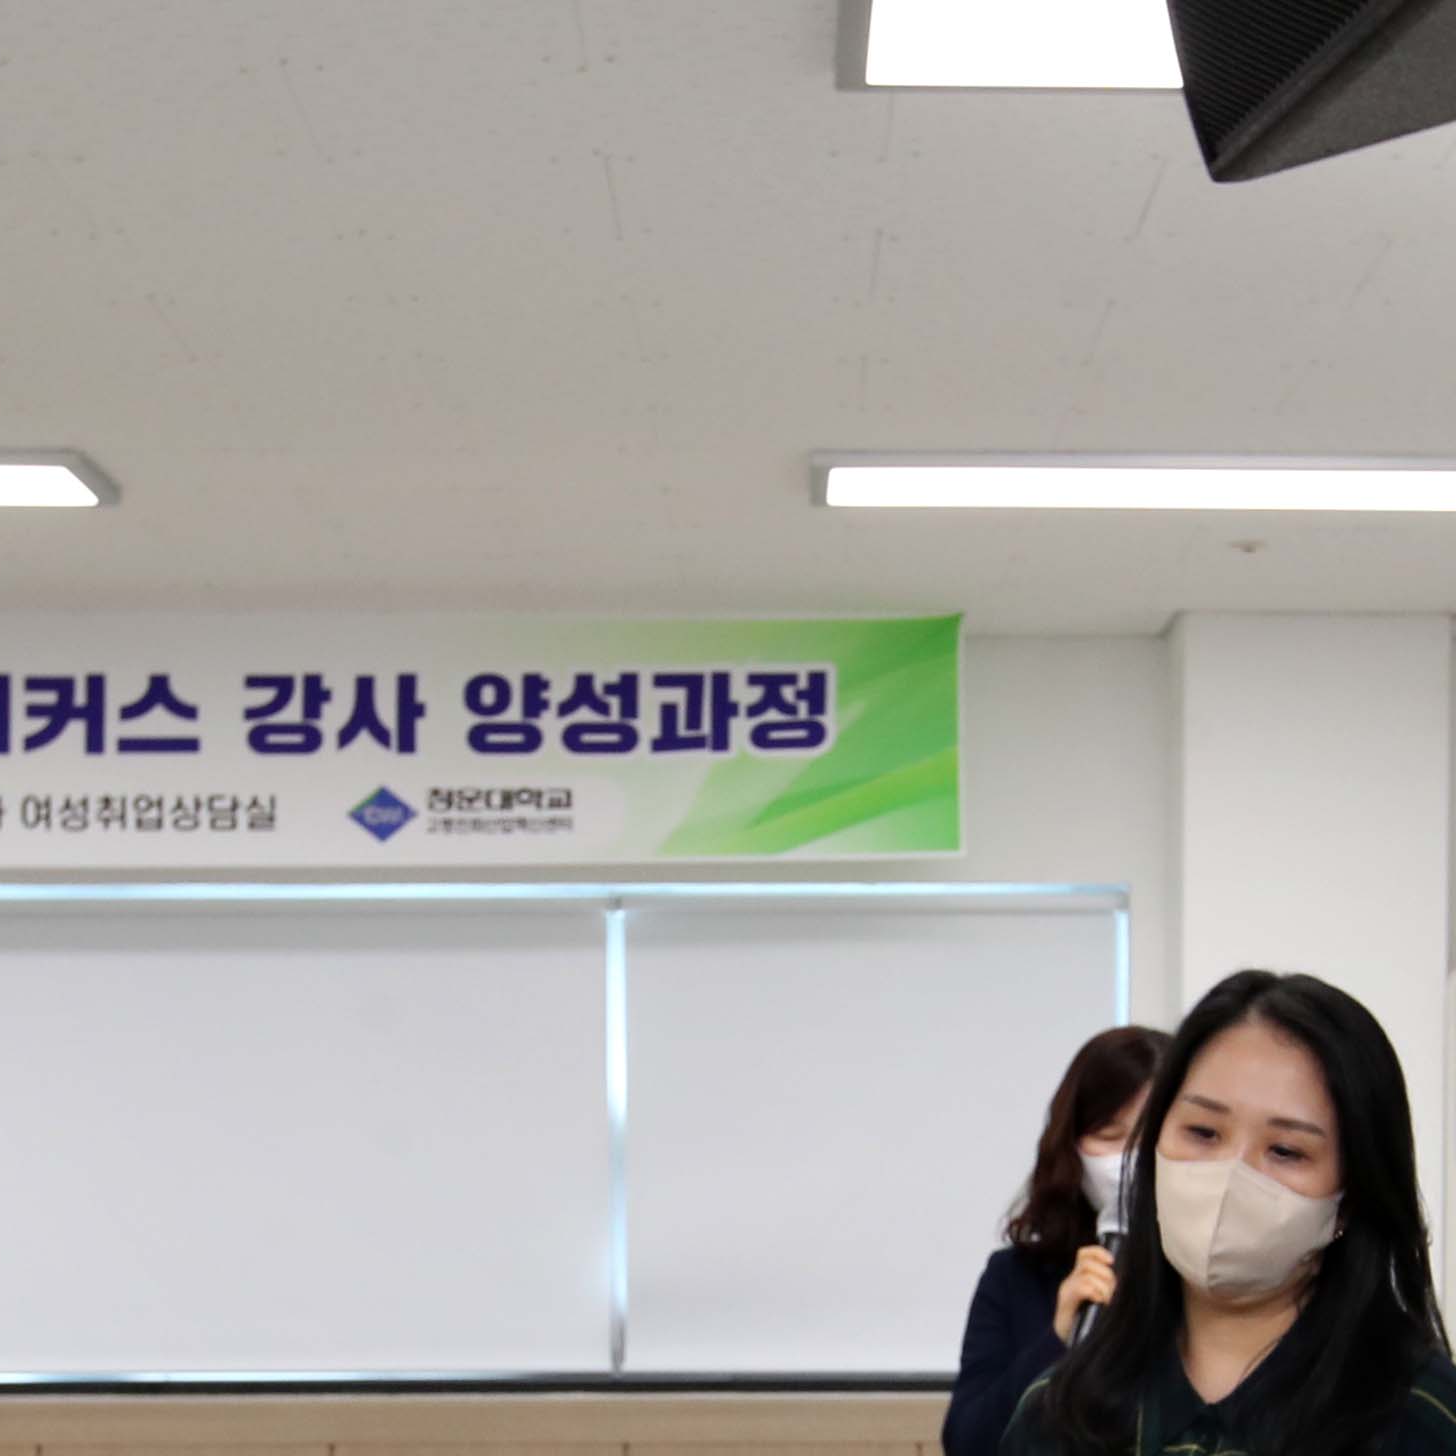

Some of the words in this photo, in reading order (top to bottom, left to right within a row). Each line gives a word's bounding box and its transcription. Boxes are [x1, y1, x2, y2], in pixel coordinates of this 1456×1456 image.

[243, 673, 427, 754] 강사
[463, 670, 829, 754] 양성과정
[20, 793, 277, 833] 여성취업상담실
